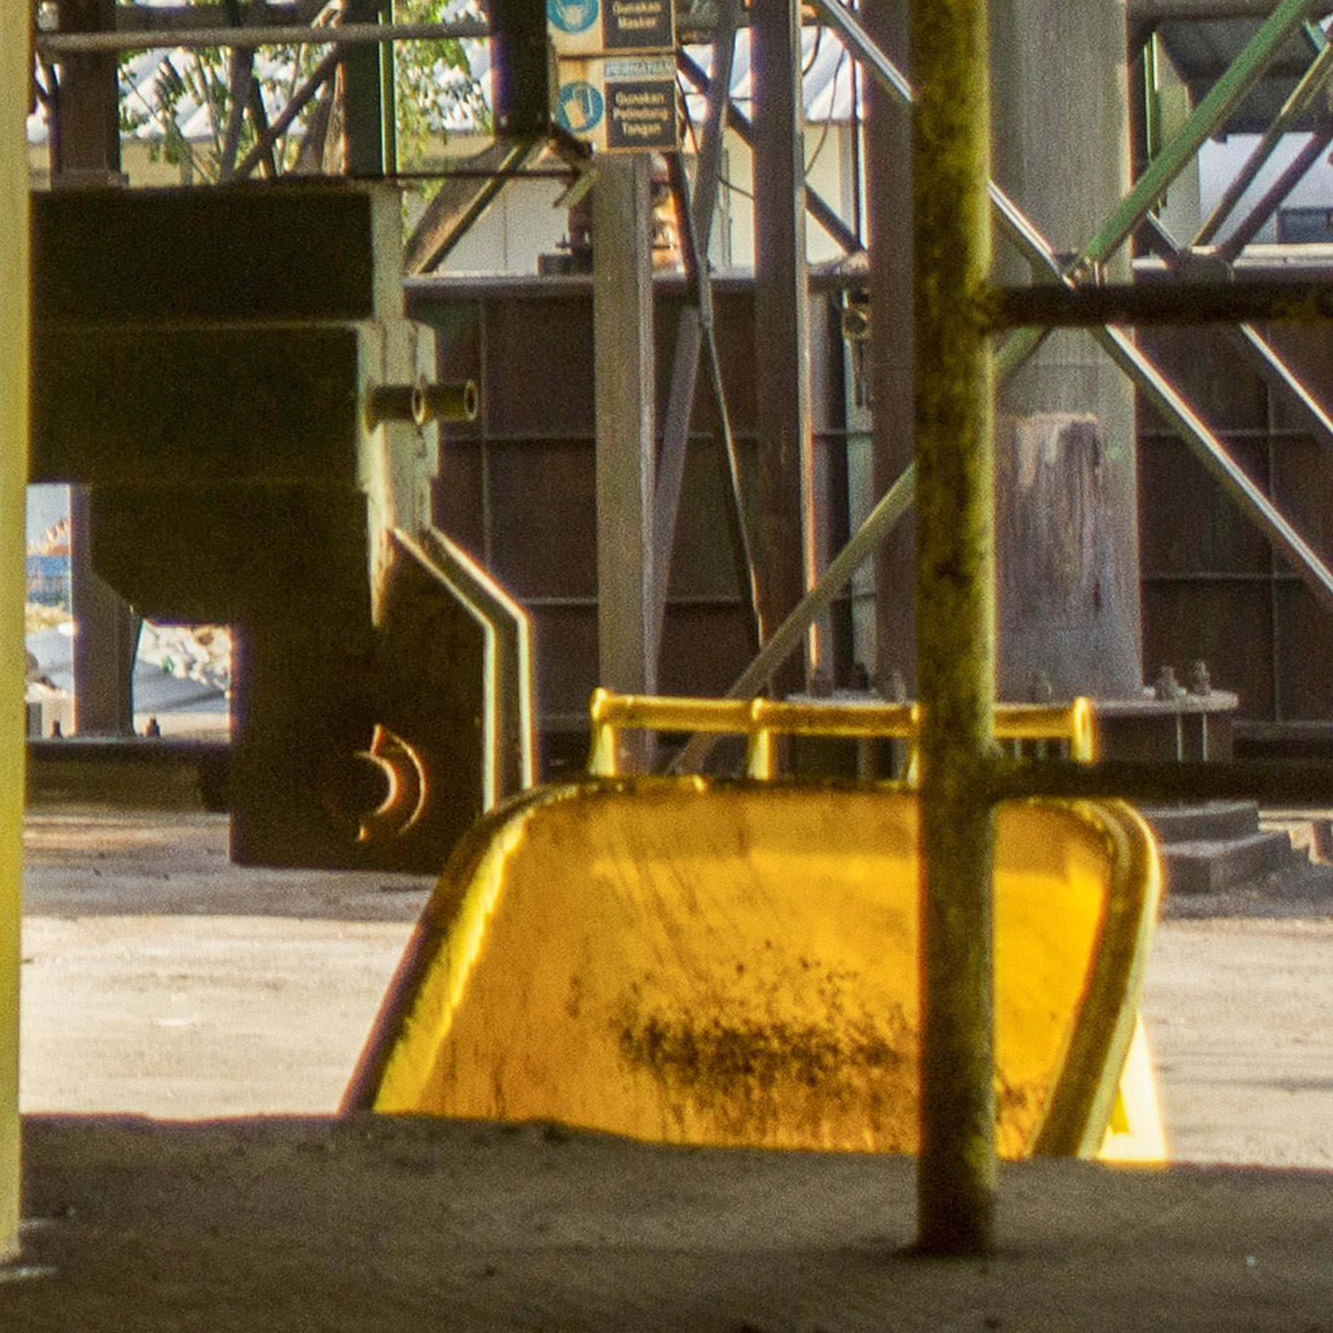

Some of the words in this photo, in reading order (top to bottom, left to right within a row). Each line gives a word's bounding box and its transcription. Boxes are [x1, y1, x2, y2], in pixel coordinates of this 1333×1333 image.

[612, 0, 662, 15] Gunakan
[617, 15, 657, 30] Masker
[615, 91, 665, 106] Gunakan
[612, 107, 670, 122] Pelindung
[622, 122, 662, 137] Tangan
